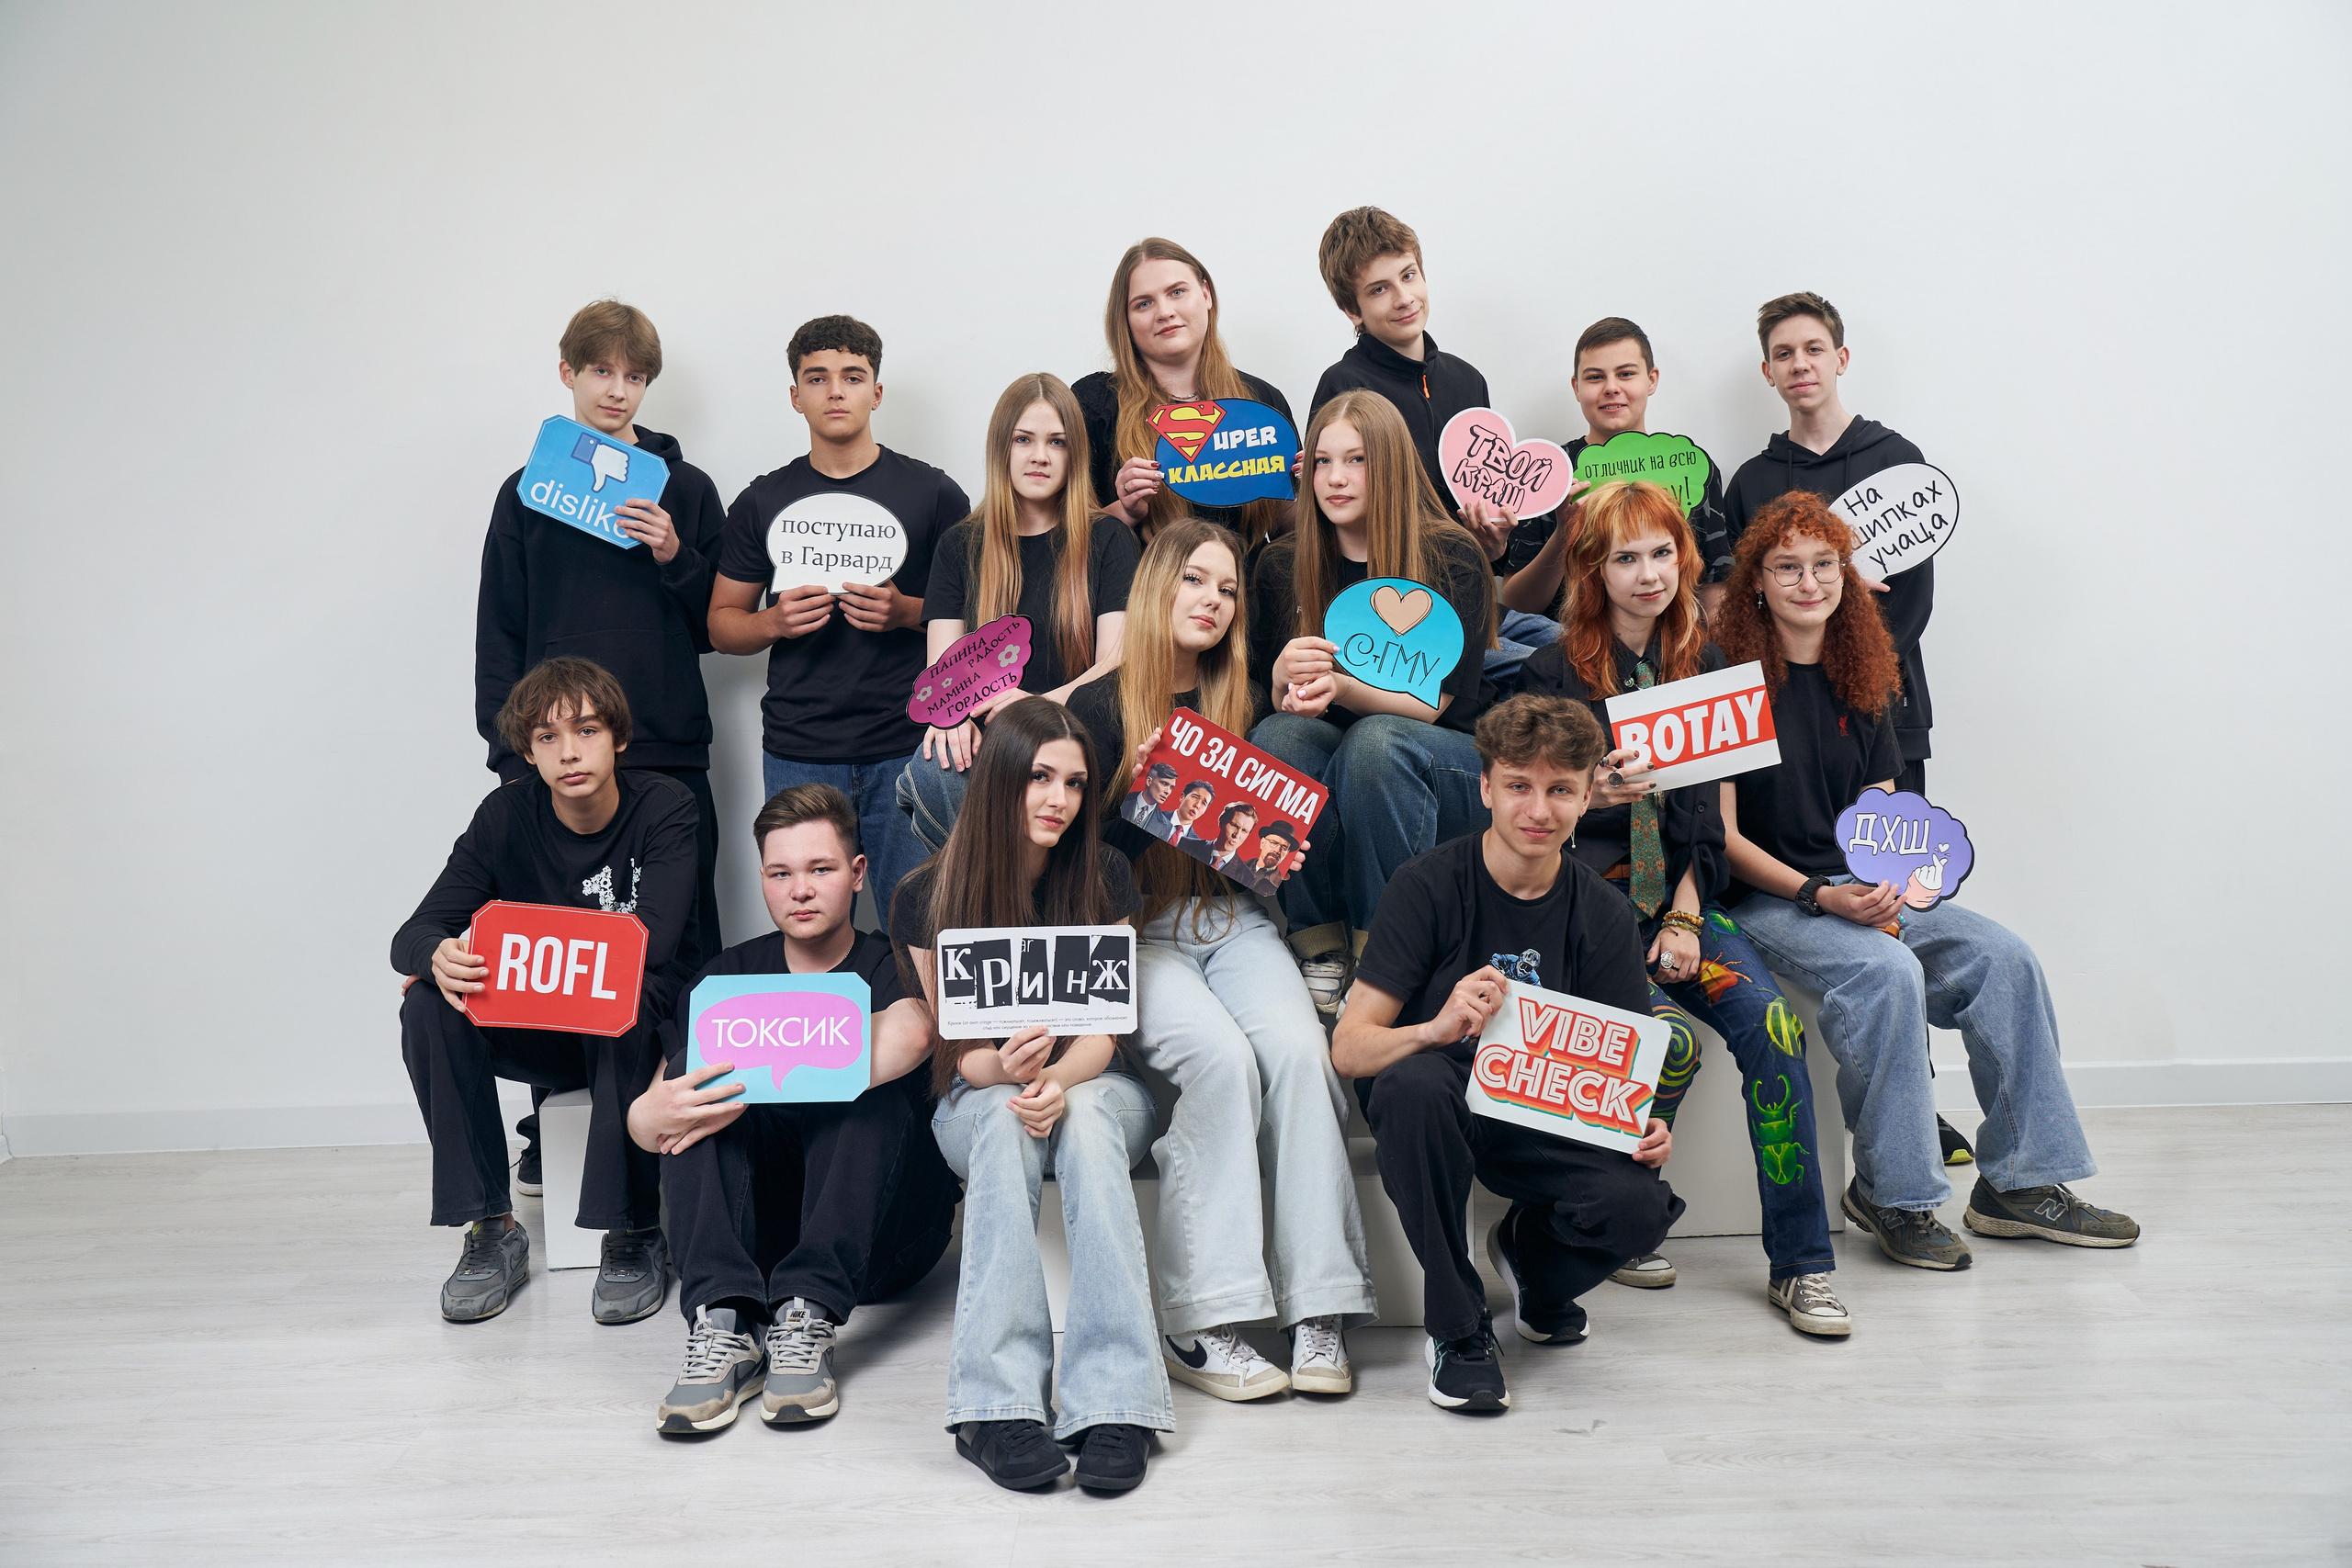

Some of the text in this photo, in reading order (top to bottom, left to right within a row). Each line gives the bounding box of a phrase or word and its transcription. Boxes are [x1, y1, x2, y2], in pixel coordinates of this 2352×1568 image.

[1168, 456, 1285, 484] КЛАССНАЯ
[1467, 424, 1553, 492] ТВОЙ
[1585, 451, 1696, 478] отличник на всю
[1453, 458, 1525, 513] КРАШ
[1843, 488, 1883, 516] На
[781, 519, 897, 542] поступаю
[1850, 480, 1942, 550] шипках
[781, 547, 893, 574] в Гарвард
[1869, 513, 1949, 574] учаца
[967, 621, 1021, 668] РАДОСТЬ
[946, 672, 1017, 717] ГОРДОСТЬ
[1619, 689, 1766, 769] BOTAY
[1170, 716, 1319, 825] ЧО ЗА СИГМА
[1849, 813, 1929, 855] ДХШ
[496, 933, 616, 999] ROFL
[711, 1016, 851, 1048] ТОКСИК
[1519, 997, 1635, 1074] VIBE
[1474, 1044, 1647, 1132] CHECK
[790, 1310, 807, 1318] NIKE
